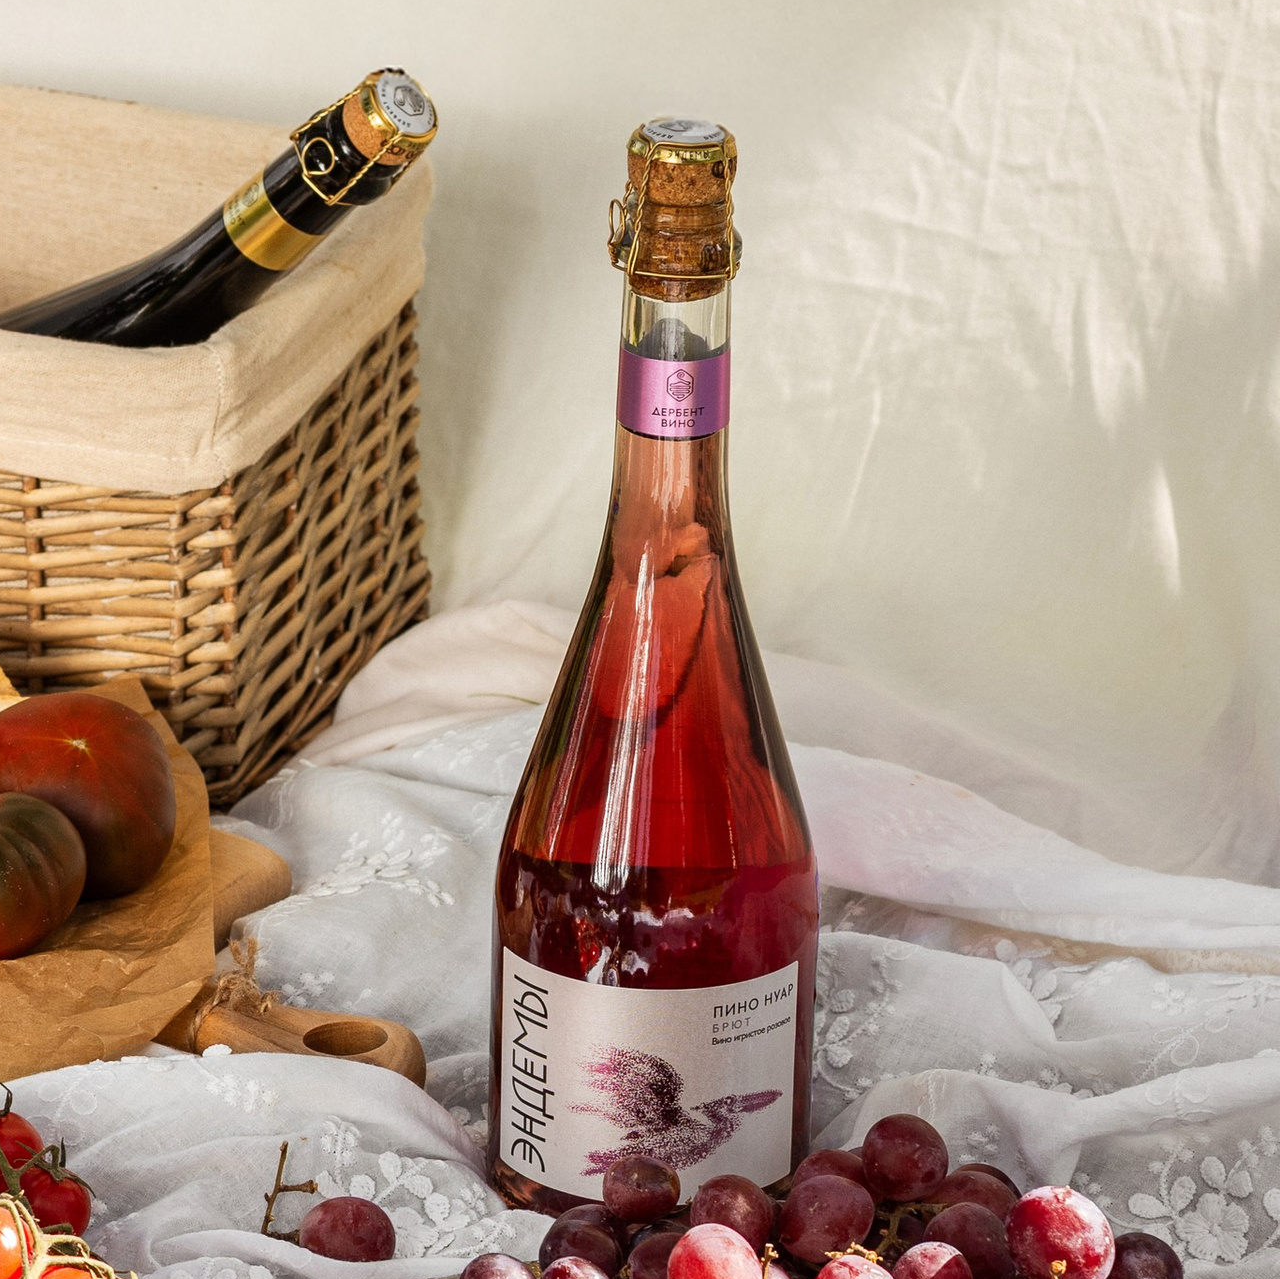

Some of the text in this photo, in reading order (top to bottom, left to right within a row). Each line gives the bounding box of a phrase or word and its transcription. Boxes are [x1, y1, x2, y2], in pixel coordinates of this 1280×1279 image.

[651, 407, 705, 417] ДЕРБЕНТ
[661, 418, 696, 428] ВИНО
[713, 983, 794, 1019] ПИНО НУАР
[712, 1017, 751, 1033] БРЮТ
[711, 1036, 733, 1046] Вино
[510, 974, 555, 1173] ЭНДЕМЫ
